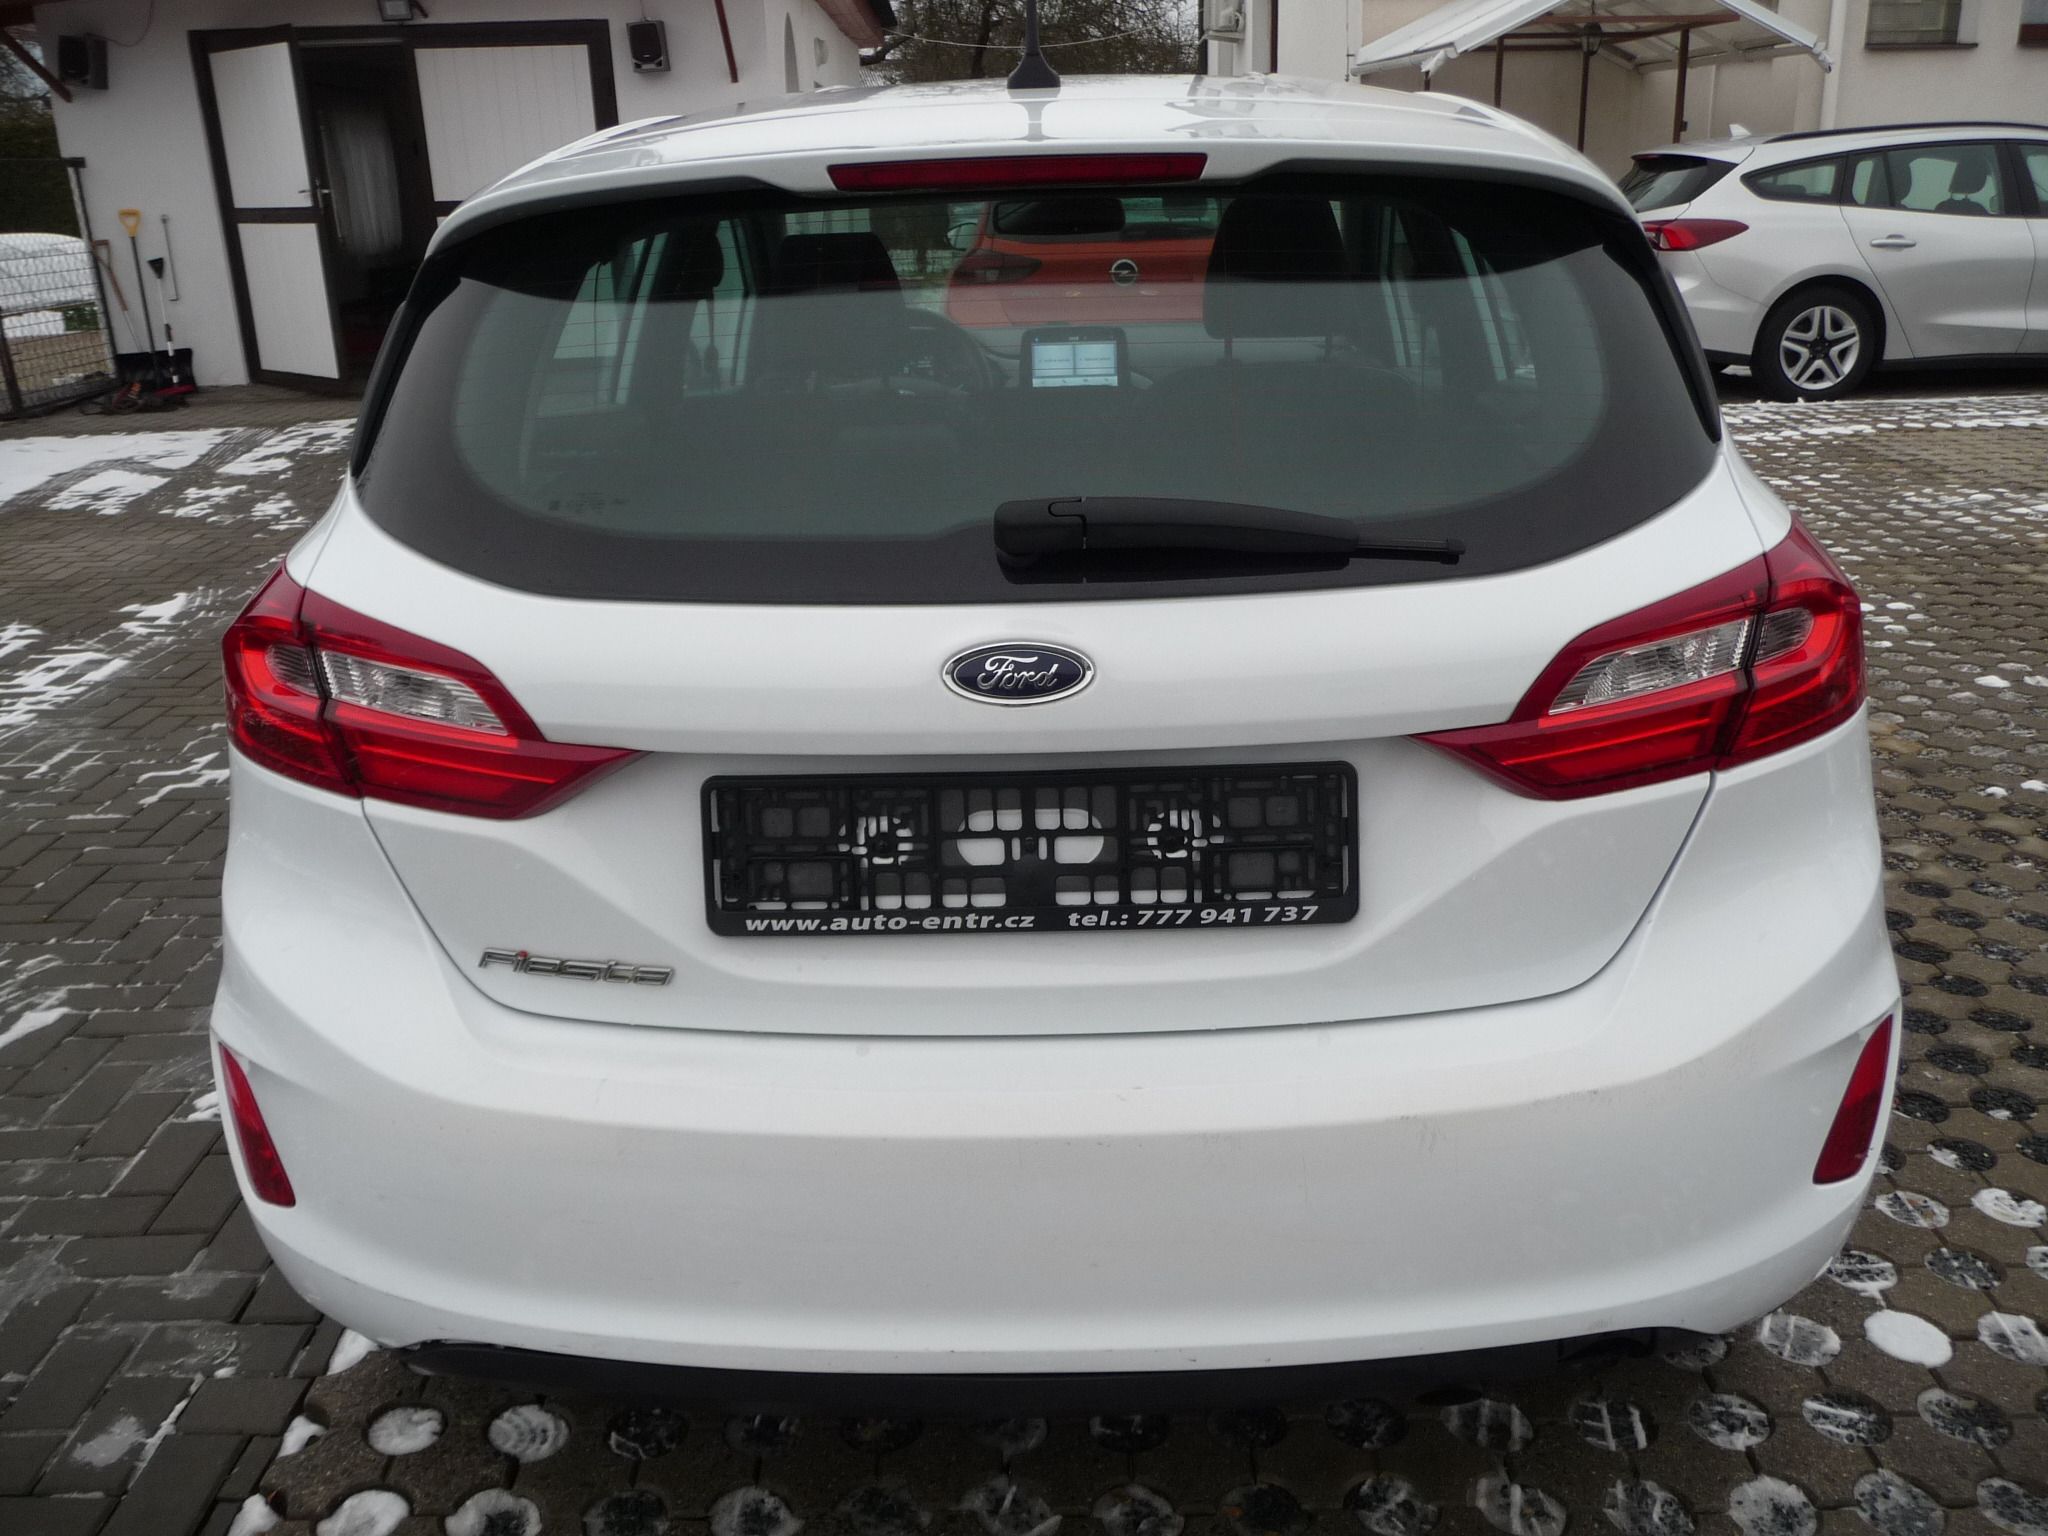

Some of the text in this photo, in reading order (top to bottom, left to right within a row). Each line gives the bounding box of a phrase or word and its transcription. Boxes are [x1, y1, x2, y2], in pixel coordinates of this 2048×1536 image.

[976, 655, 1059, 690] Ford
[744, 905, 1319, 932] www.auto-entr.cz tel.: 777 941 737
[478, 948, 675, 985] Fiesta
